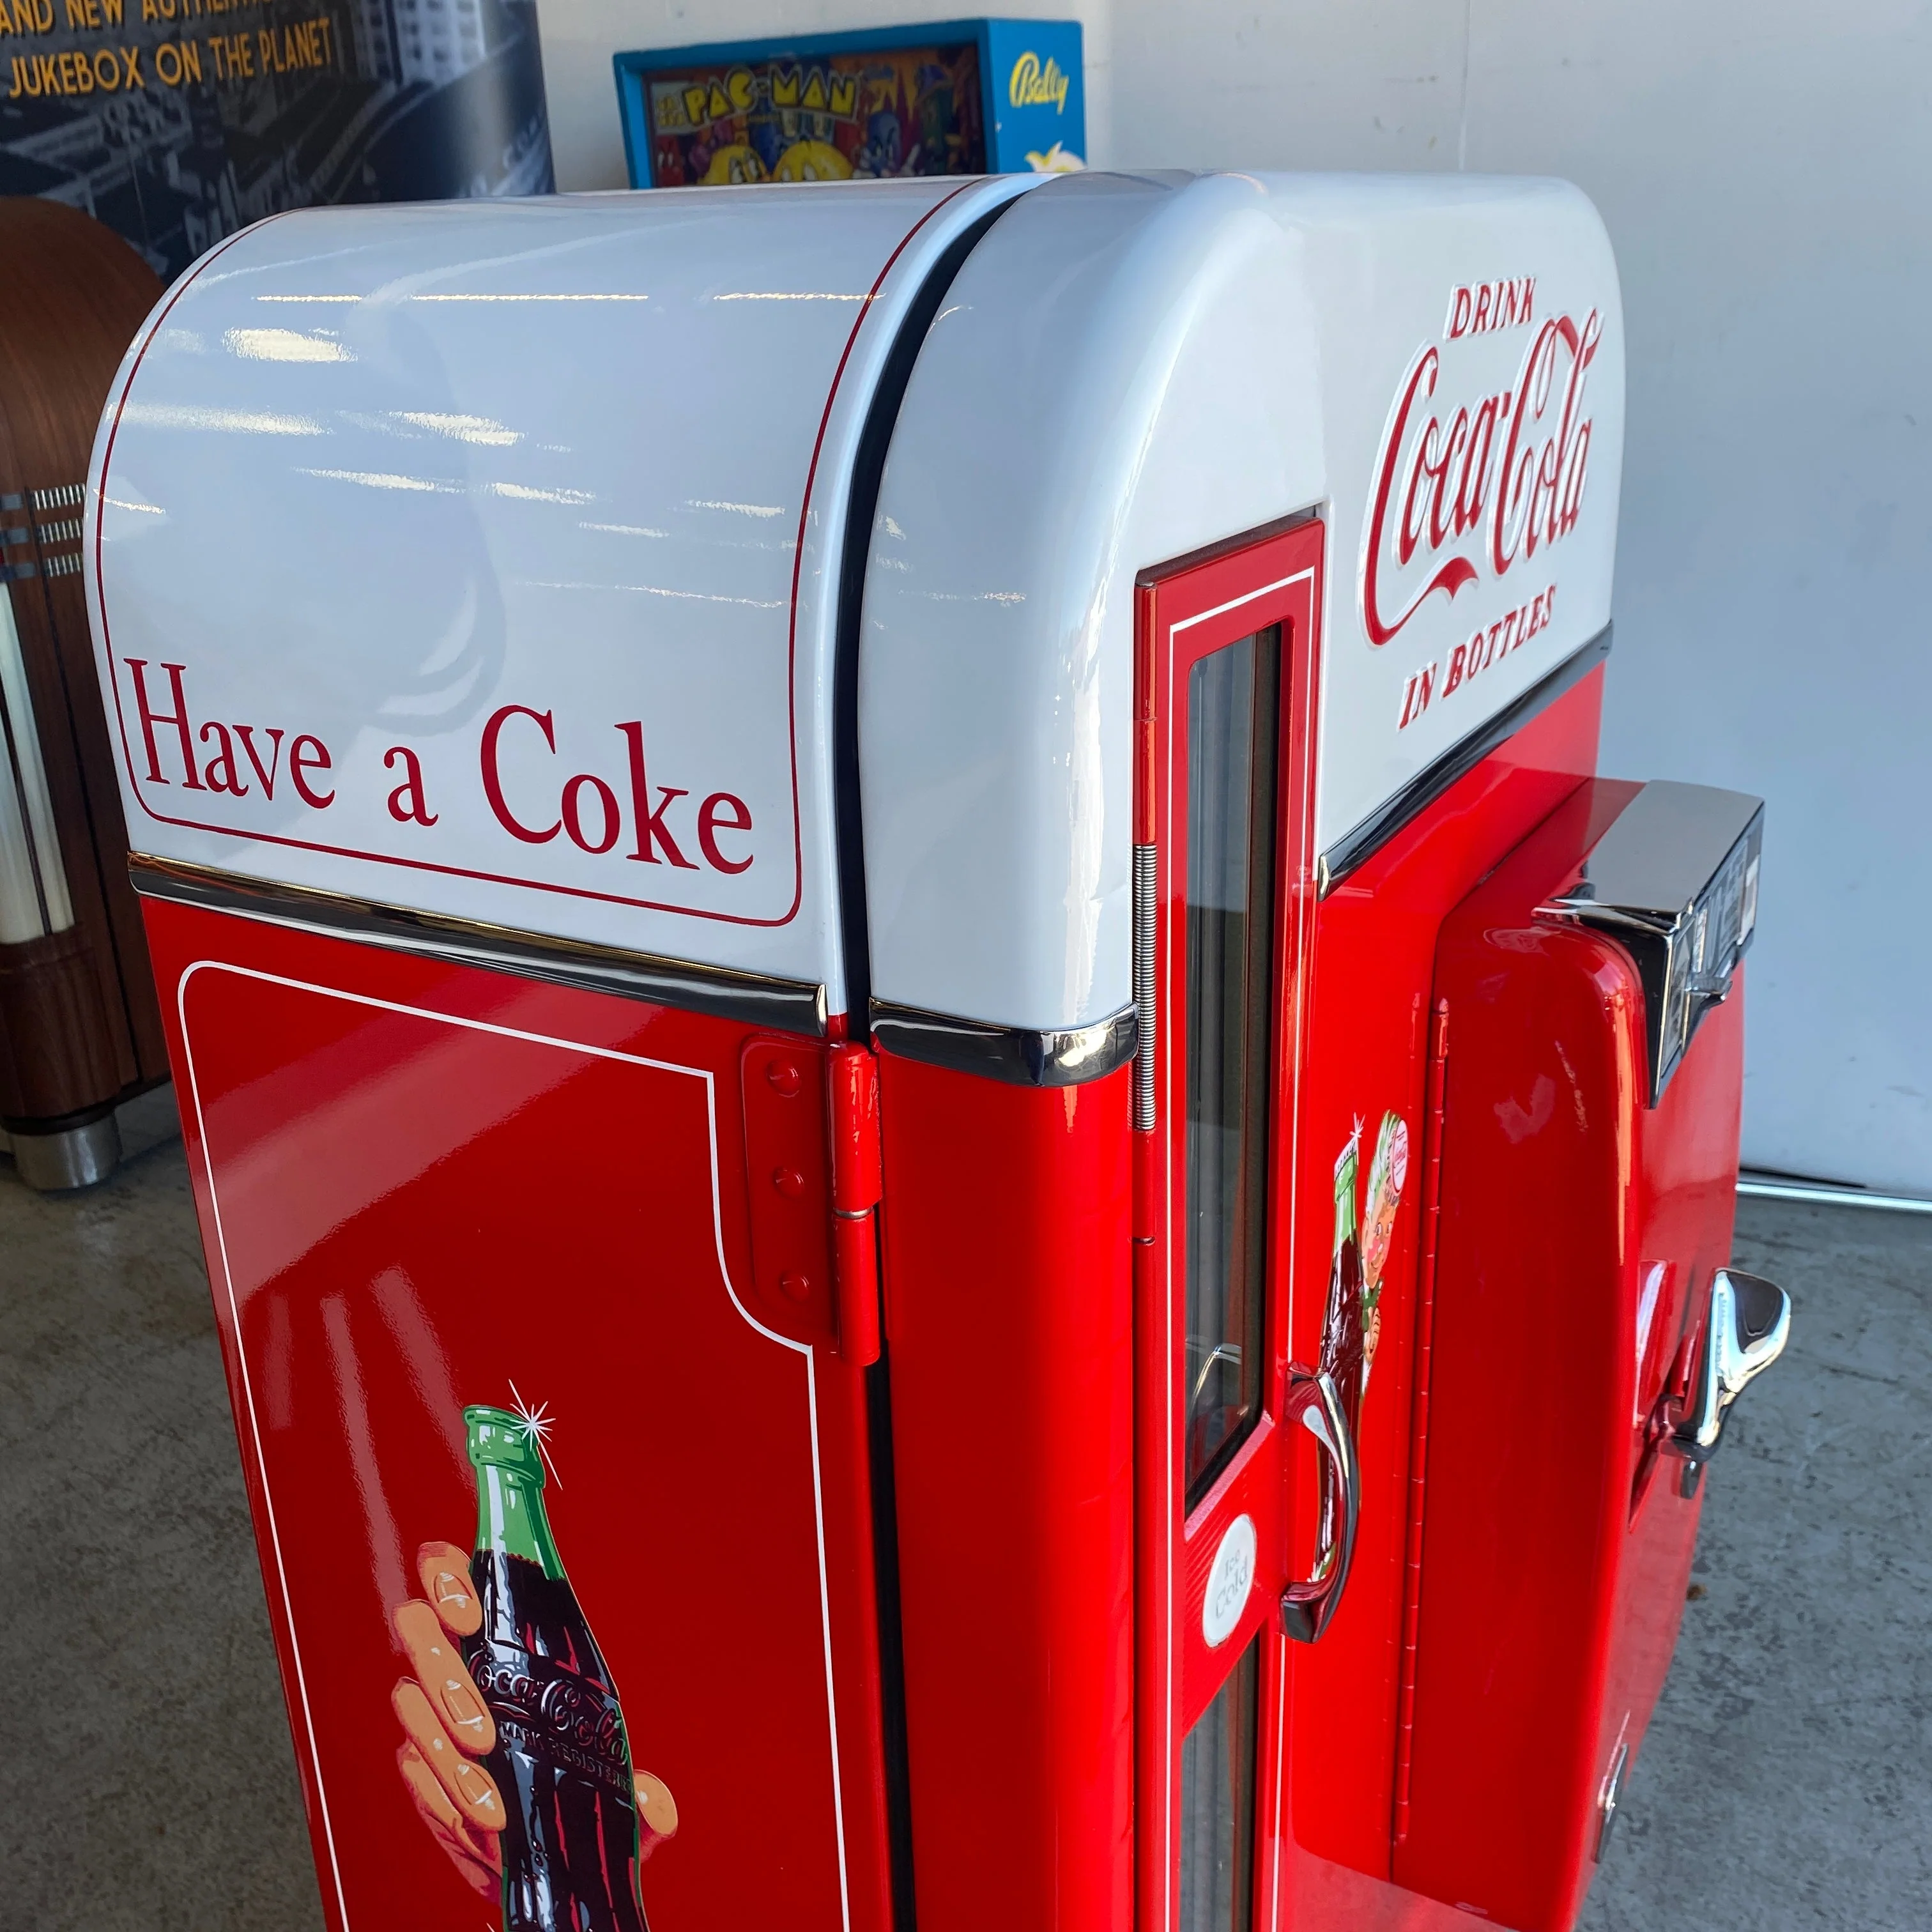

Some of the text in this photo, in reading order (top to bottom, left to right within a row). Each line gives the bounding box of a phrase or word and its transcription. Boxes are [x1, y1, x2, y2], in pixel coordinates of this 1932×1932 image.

[66, 0, 125, 29] NEW
[9, 17, 331, 99] JUKEBOX ON THE PLANET
[1009, 50, 1070, 116] Bally
[682, 68, 856, 125] PAC-MAN
[1449, 277, 1536, 339] DRINK
[1362, 305, 1602, 646] Coca-Cola
[1399, 583, 1557, 730] IN BOTTLES
[123, 657, 754, 875] Have a Coke
[1215, 1555, 1248, 1620] Cold
